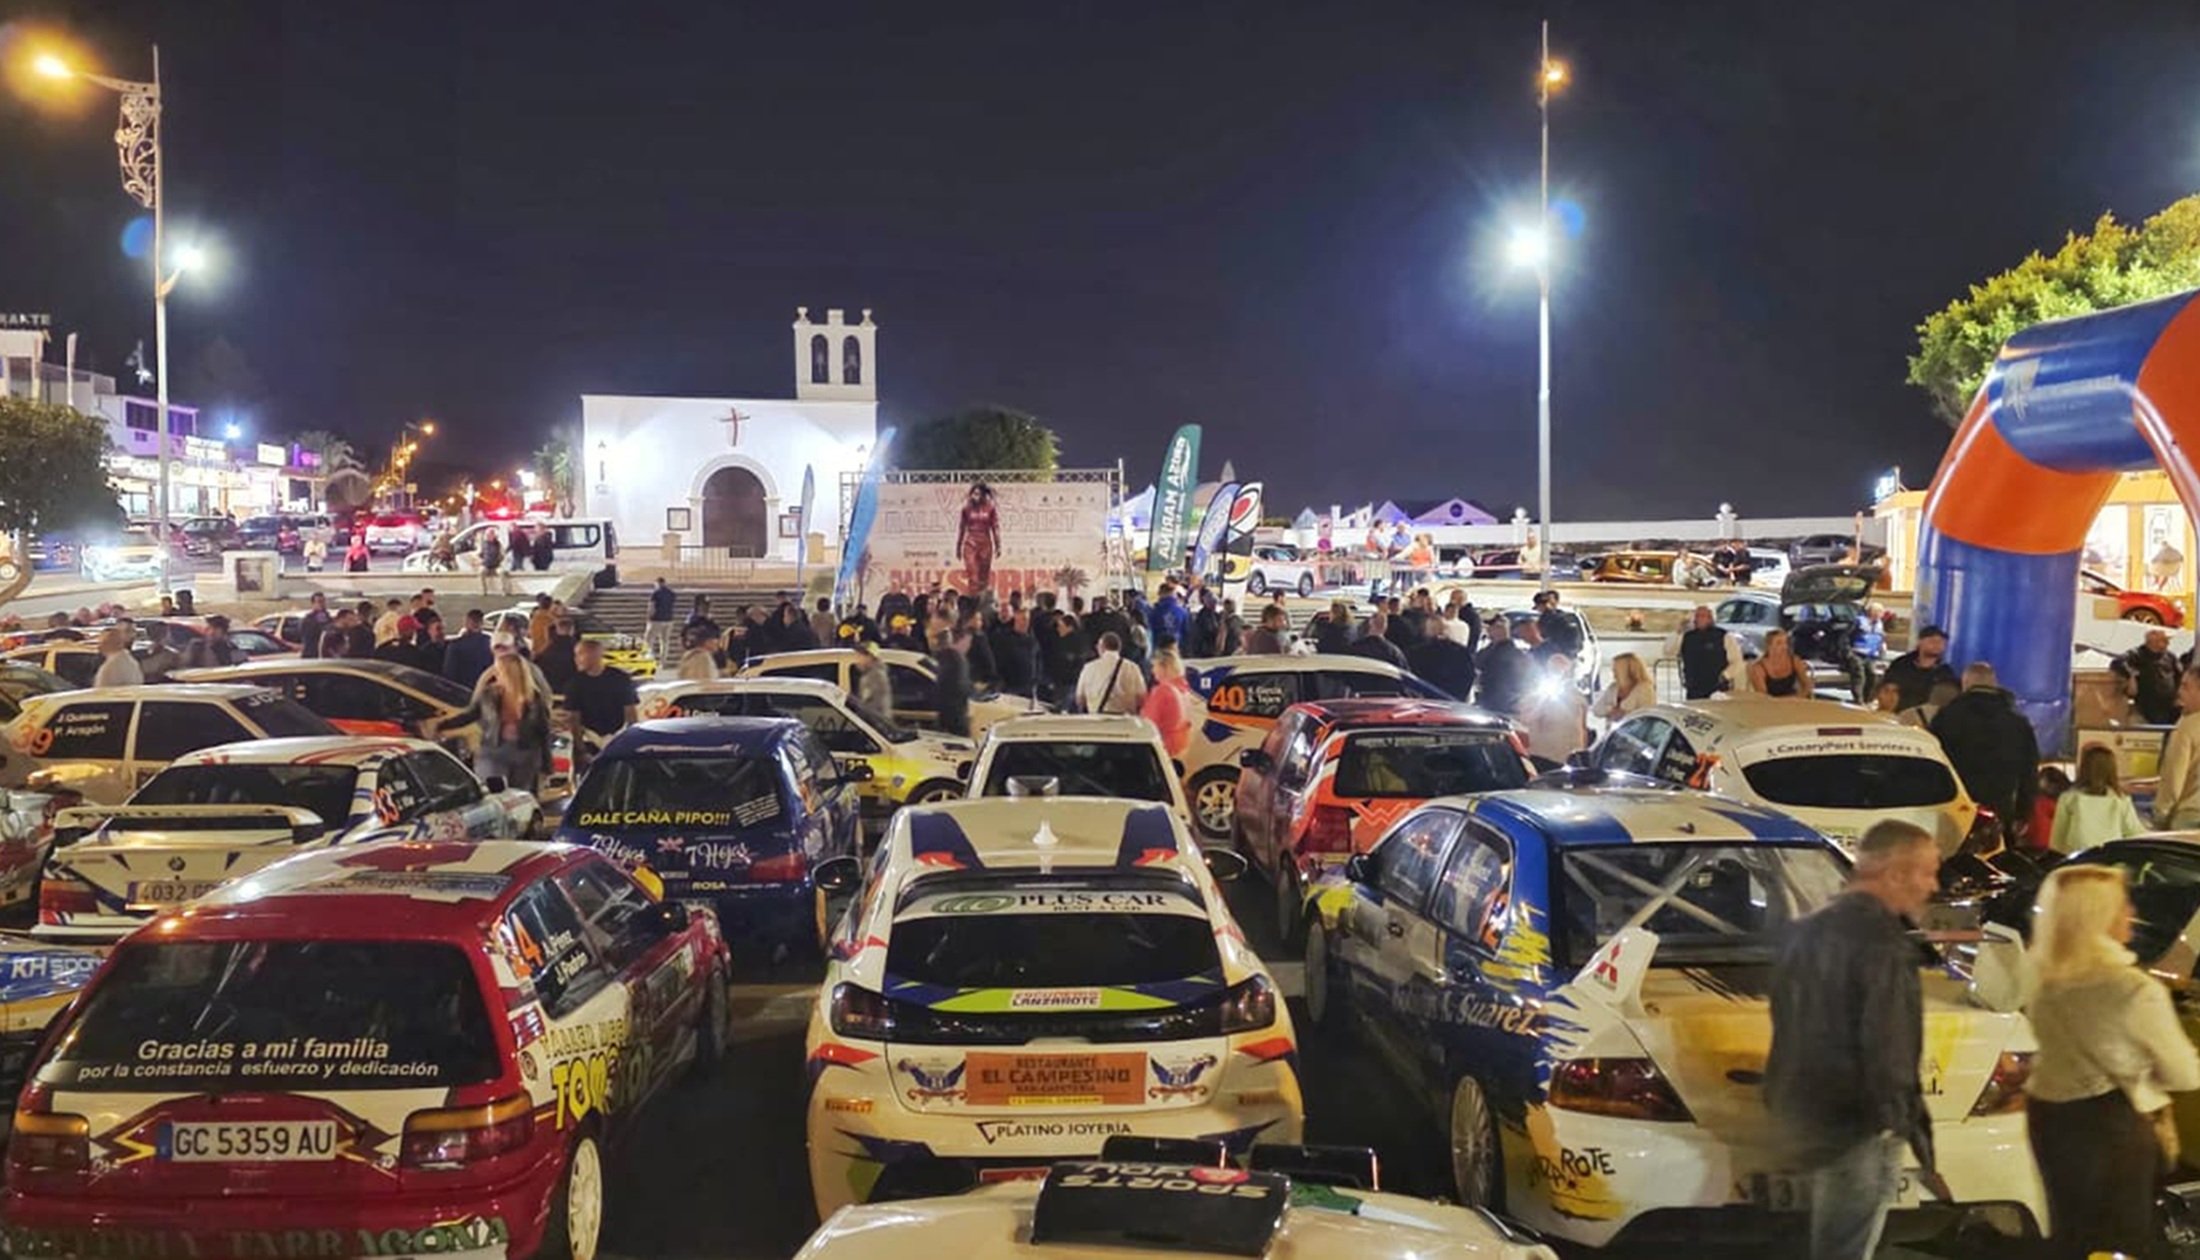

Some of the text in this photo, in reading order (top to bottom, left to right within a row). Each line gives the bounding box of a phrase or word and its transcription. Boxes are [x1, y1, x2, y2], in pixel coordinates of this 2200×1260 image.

[1210, 685, 1246, 711] 40
[1859, 741, 1911, 752] Services
[579, 809, 731, 826] DALE CAÑA PIPO!!!
[1020, 894, 1167, 906] PLUS CAR
[11, 956, 47, 979] KH
[1012, 996, 1098, 1007] LANZAROTE
[138, 1037, 389, 1060] Gracias a mi familia
[78, 1060, 439, 1082] por la constancia esfuerzo y dedicación
[982, 1069, 1131, 1084] EL CAMPESINO
[175, 1126, 332, 1155] GC 5359 AU
[997, 1123, 1064, 1137] PLATINO
[1059, 1175, 1271, 1198] SPORTS
[219, 1216, 511, 1257] TARRAGONA
